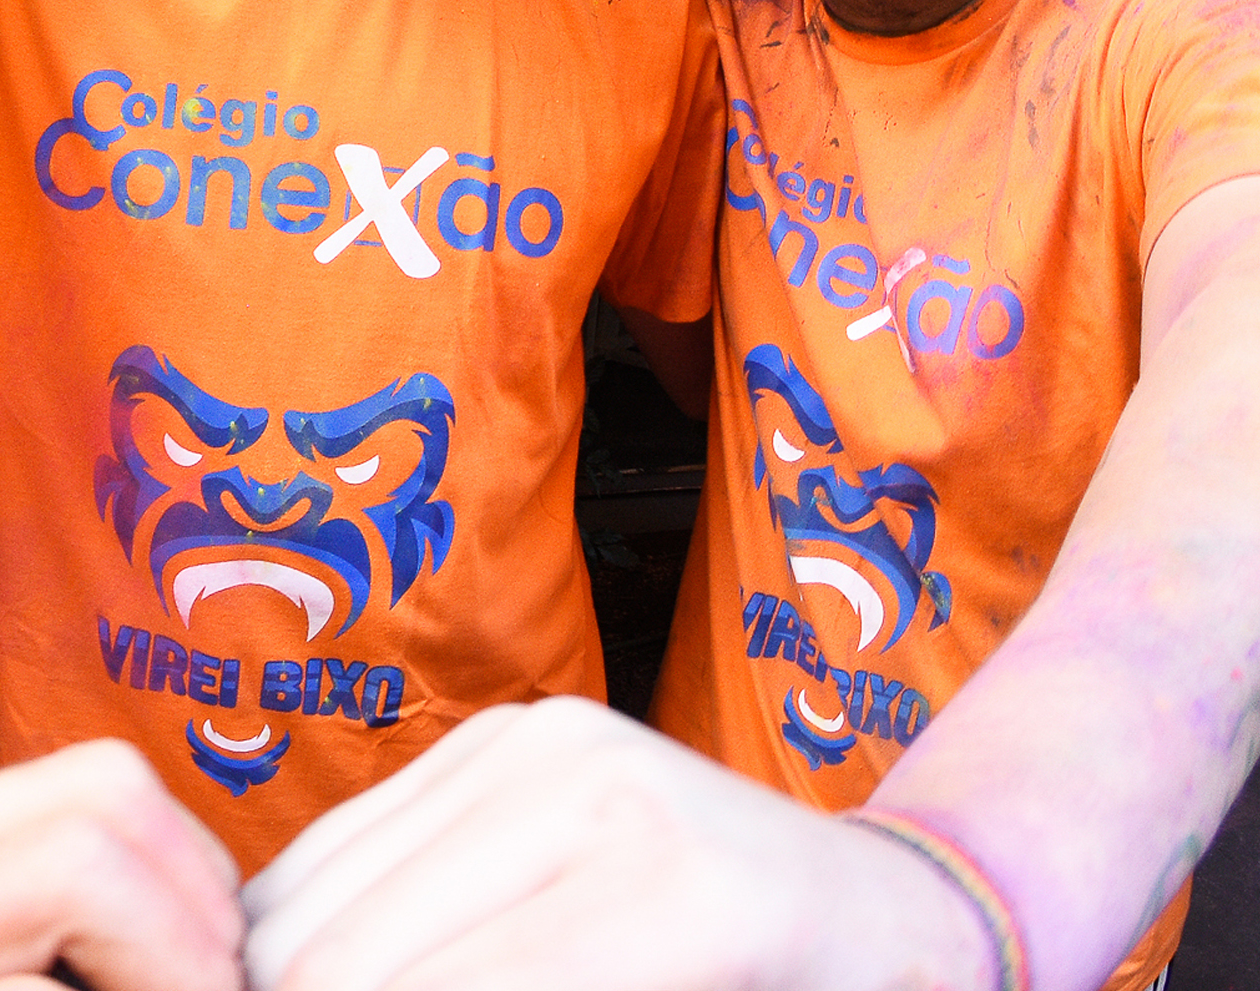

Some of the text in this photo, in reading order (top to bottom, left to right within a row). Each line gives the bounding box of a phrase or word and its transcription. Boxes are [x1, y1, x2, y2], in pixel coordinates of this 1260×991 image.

[72, 69, 320, 151] Colégio
[97, 614, 405, 729] VIREI BIXO
